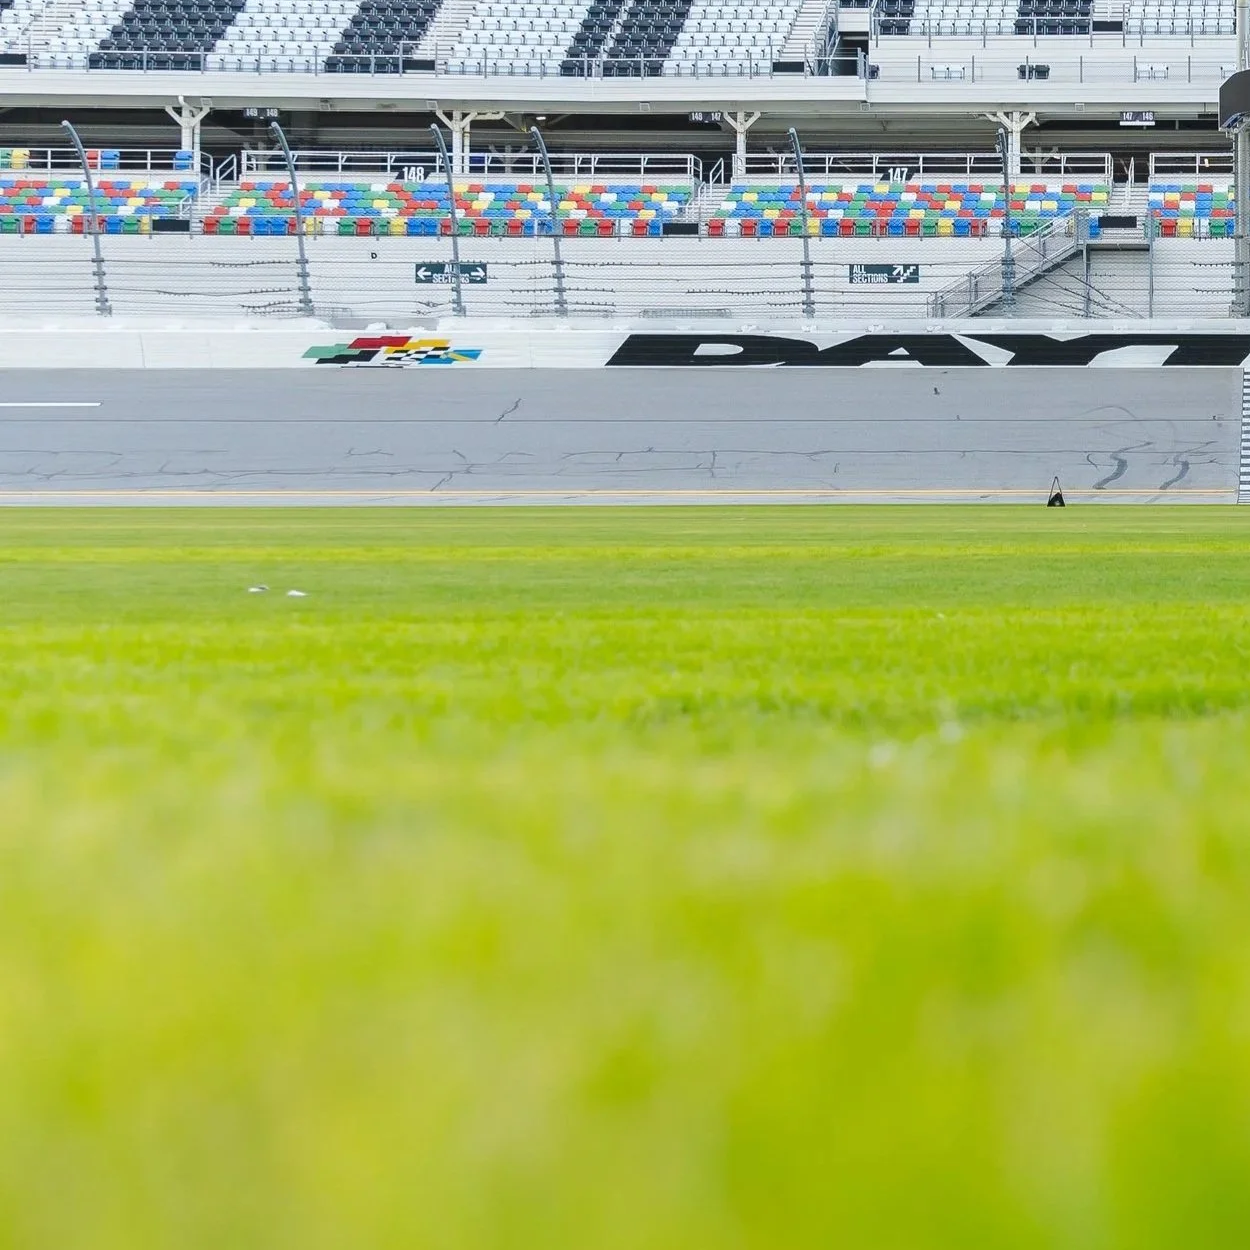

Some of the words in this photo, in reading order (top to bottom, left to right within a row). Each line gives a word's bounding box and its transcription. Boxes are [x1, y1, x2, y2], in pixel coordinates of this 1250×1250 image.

[402, 166, 424, 183] 148
[888, 167, 908, 184] 147
[853, 265, 866, 274] ALL
[852, 274, 888, 283] SECTIONS
